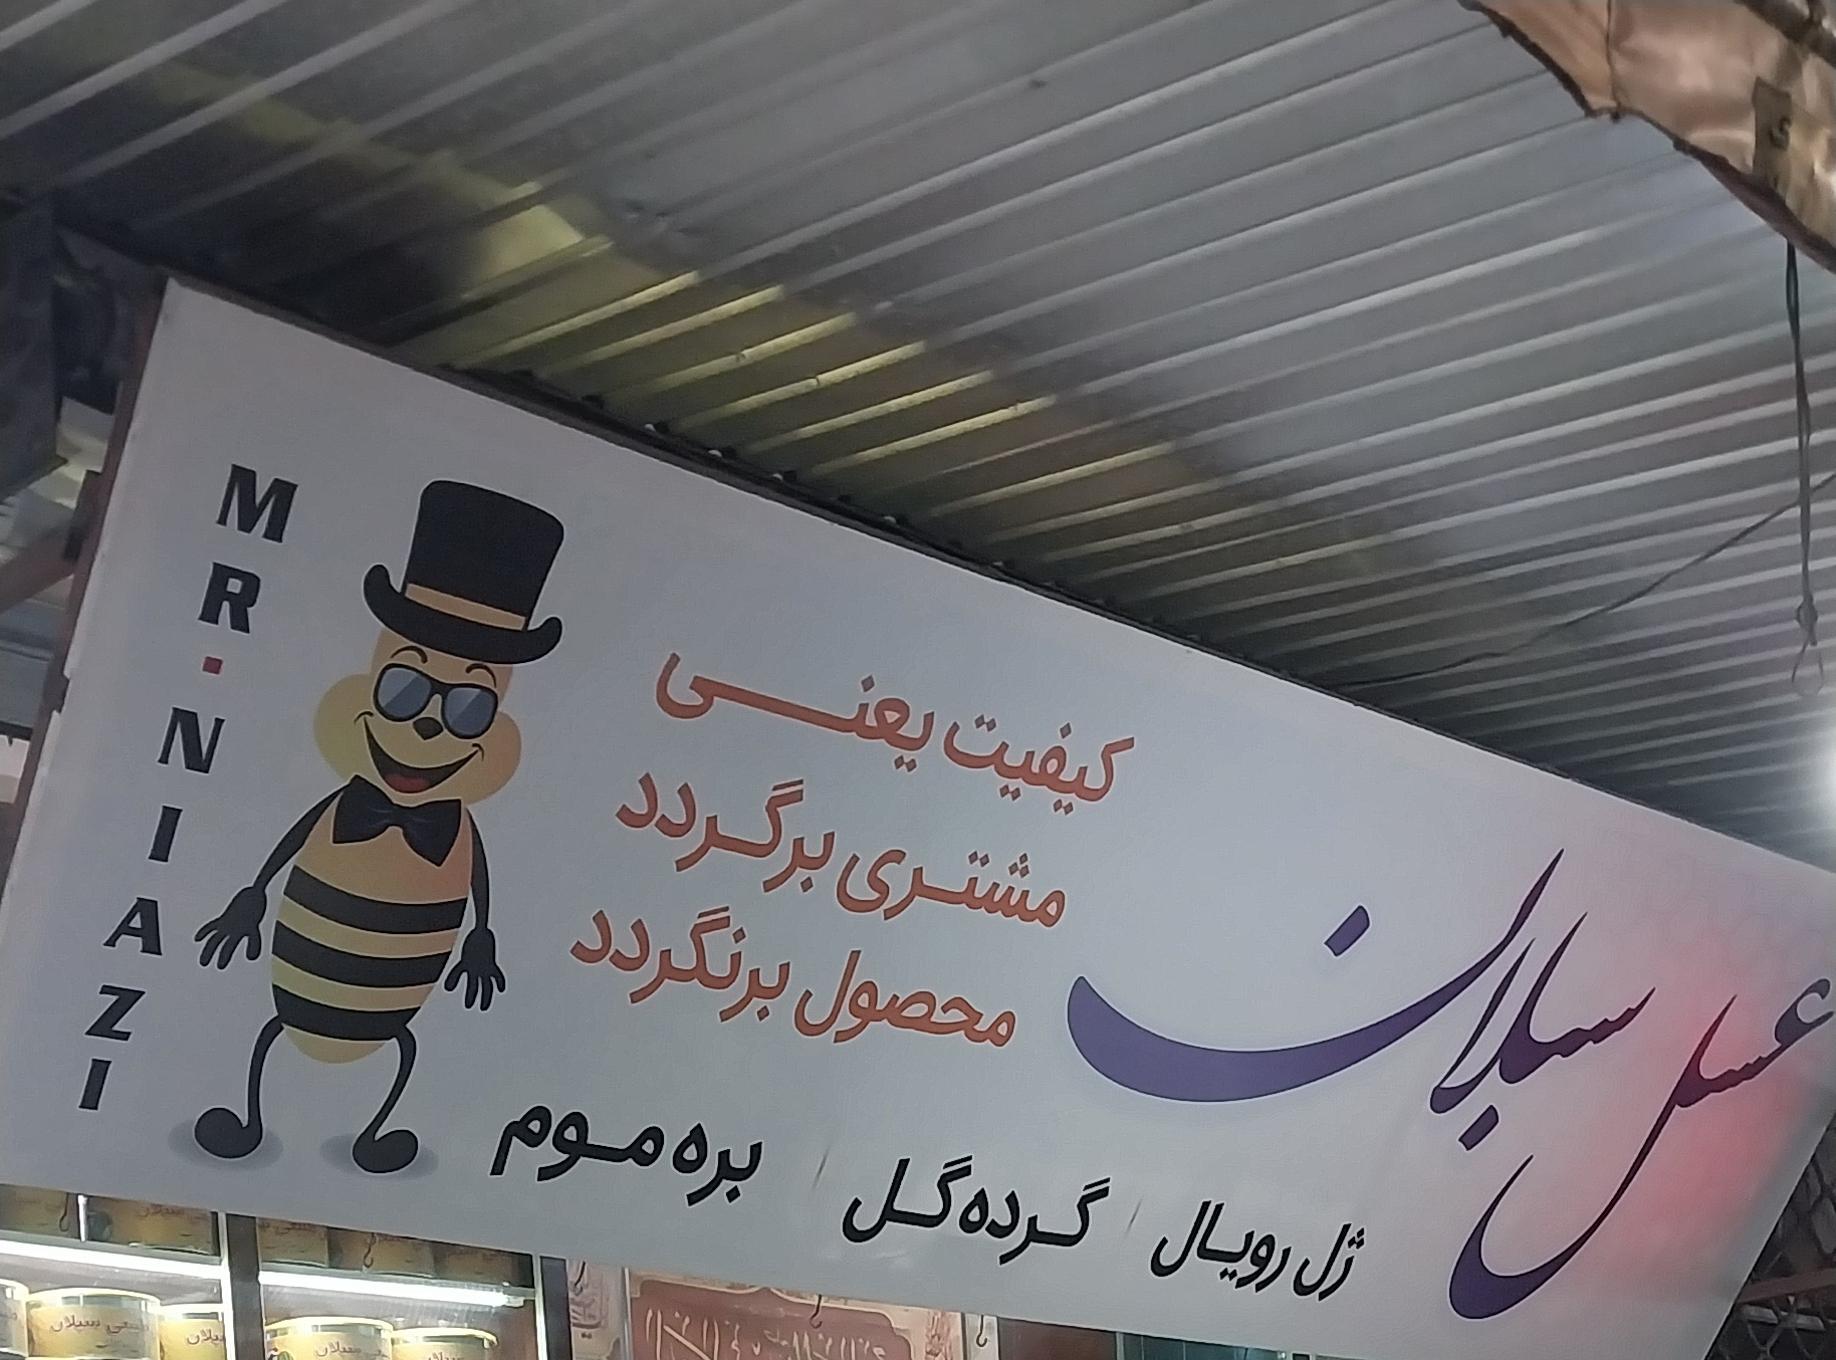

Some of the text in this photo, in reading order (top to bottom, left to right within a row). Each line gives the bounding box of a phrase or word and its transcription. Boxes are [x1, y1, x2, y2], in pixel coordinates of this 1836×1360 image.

[655, 652, 1136, 815] کیفیت یعنی
[615, 778, 1067, 927] مشتری برگردد
[570, 905, 1017, 1048] محصول برنگردد
[489, 1104, 763, 1206] بره موم
[1067, 848, 1835, 1319] عسل سبلان
[842, 1154, 1111, 1265] گرده گل
[1151, 1201, 1364, 1300] ژل رویال
